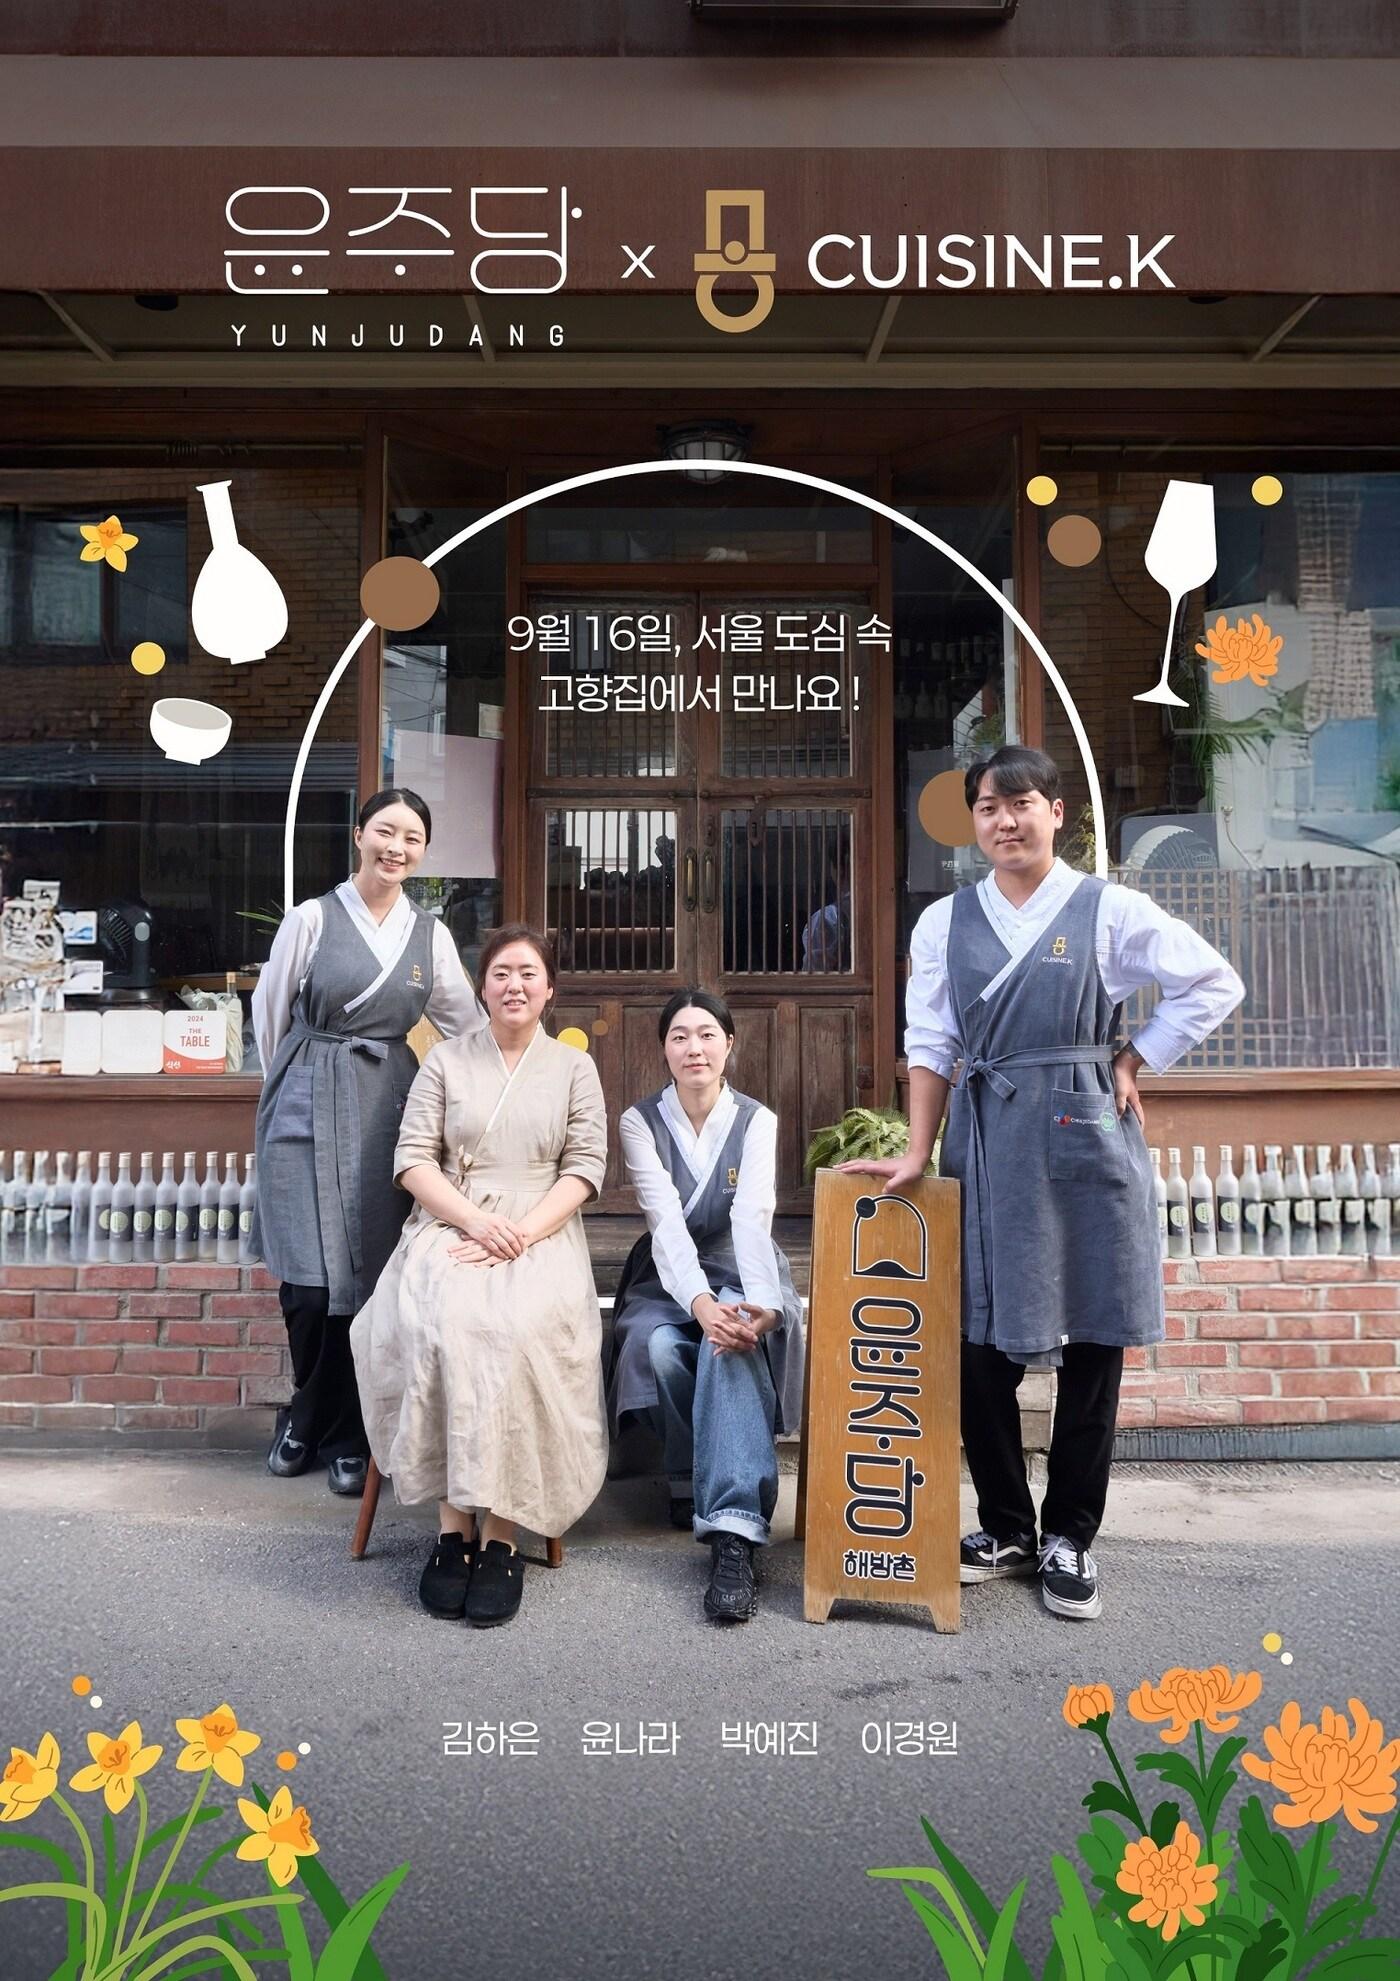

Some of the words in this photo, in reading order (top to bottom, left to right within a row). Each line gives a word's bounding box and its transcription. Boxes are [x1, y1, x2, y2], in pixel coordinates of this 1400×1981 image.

[180, 1035, 210, 1047] TABLE
[844, 1296, 926, 1538] 윤주당
[843, 1550, 917, 1583] 해방촌
